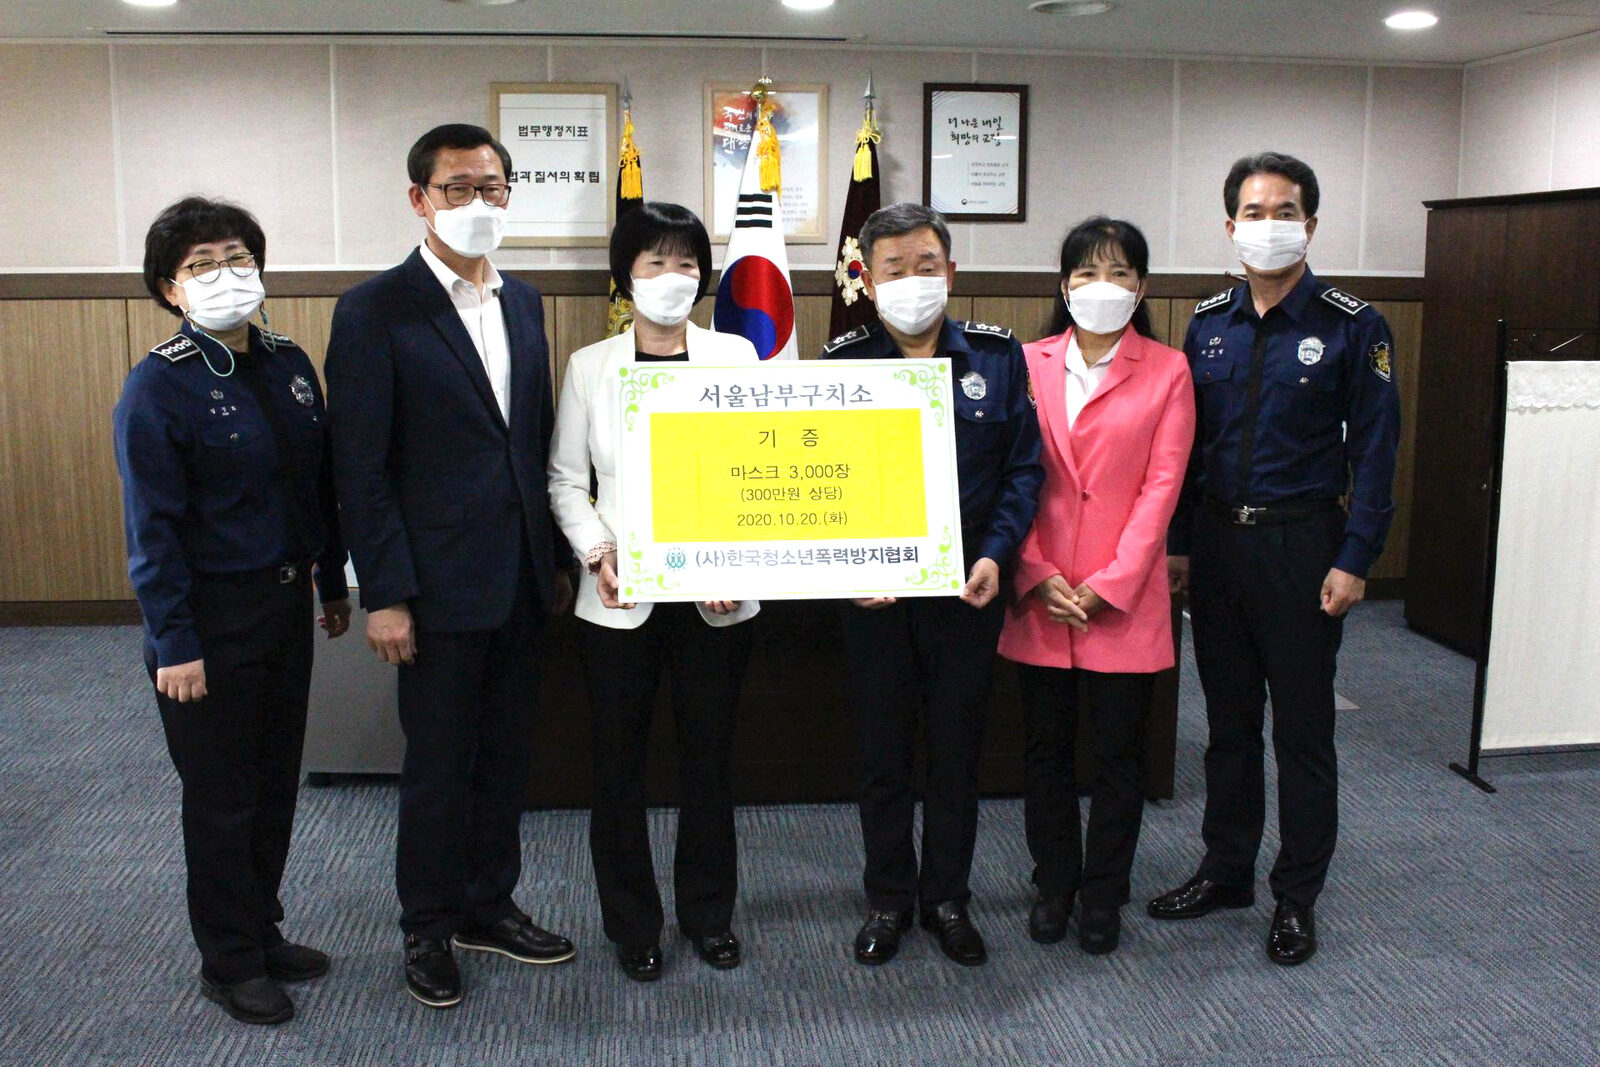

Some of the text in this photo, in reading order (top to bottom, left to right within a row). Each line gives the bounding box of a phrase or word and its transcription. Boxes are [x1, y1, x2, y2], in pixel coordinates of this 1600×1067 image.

[518, 125, 588, 137] 법무행정지표
[535, 171, 570, 183] 질서의
[574, 171, 600, 183] 확립
[699, 383, 873, 408] 서울남부구치소
[731, 464, 851, 480] 마스크 3,000장
[741, 486, 843, 502] (300만원 상당)
[737, 512, 848, 526] 2020.10.20.(화)
[695, 546, 919, 567] (사)한국청소년폭력방지협회
